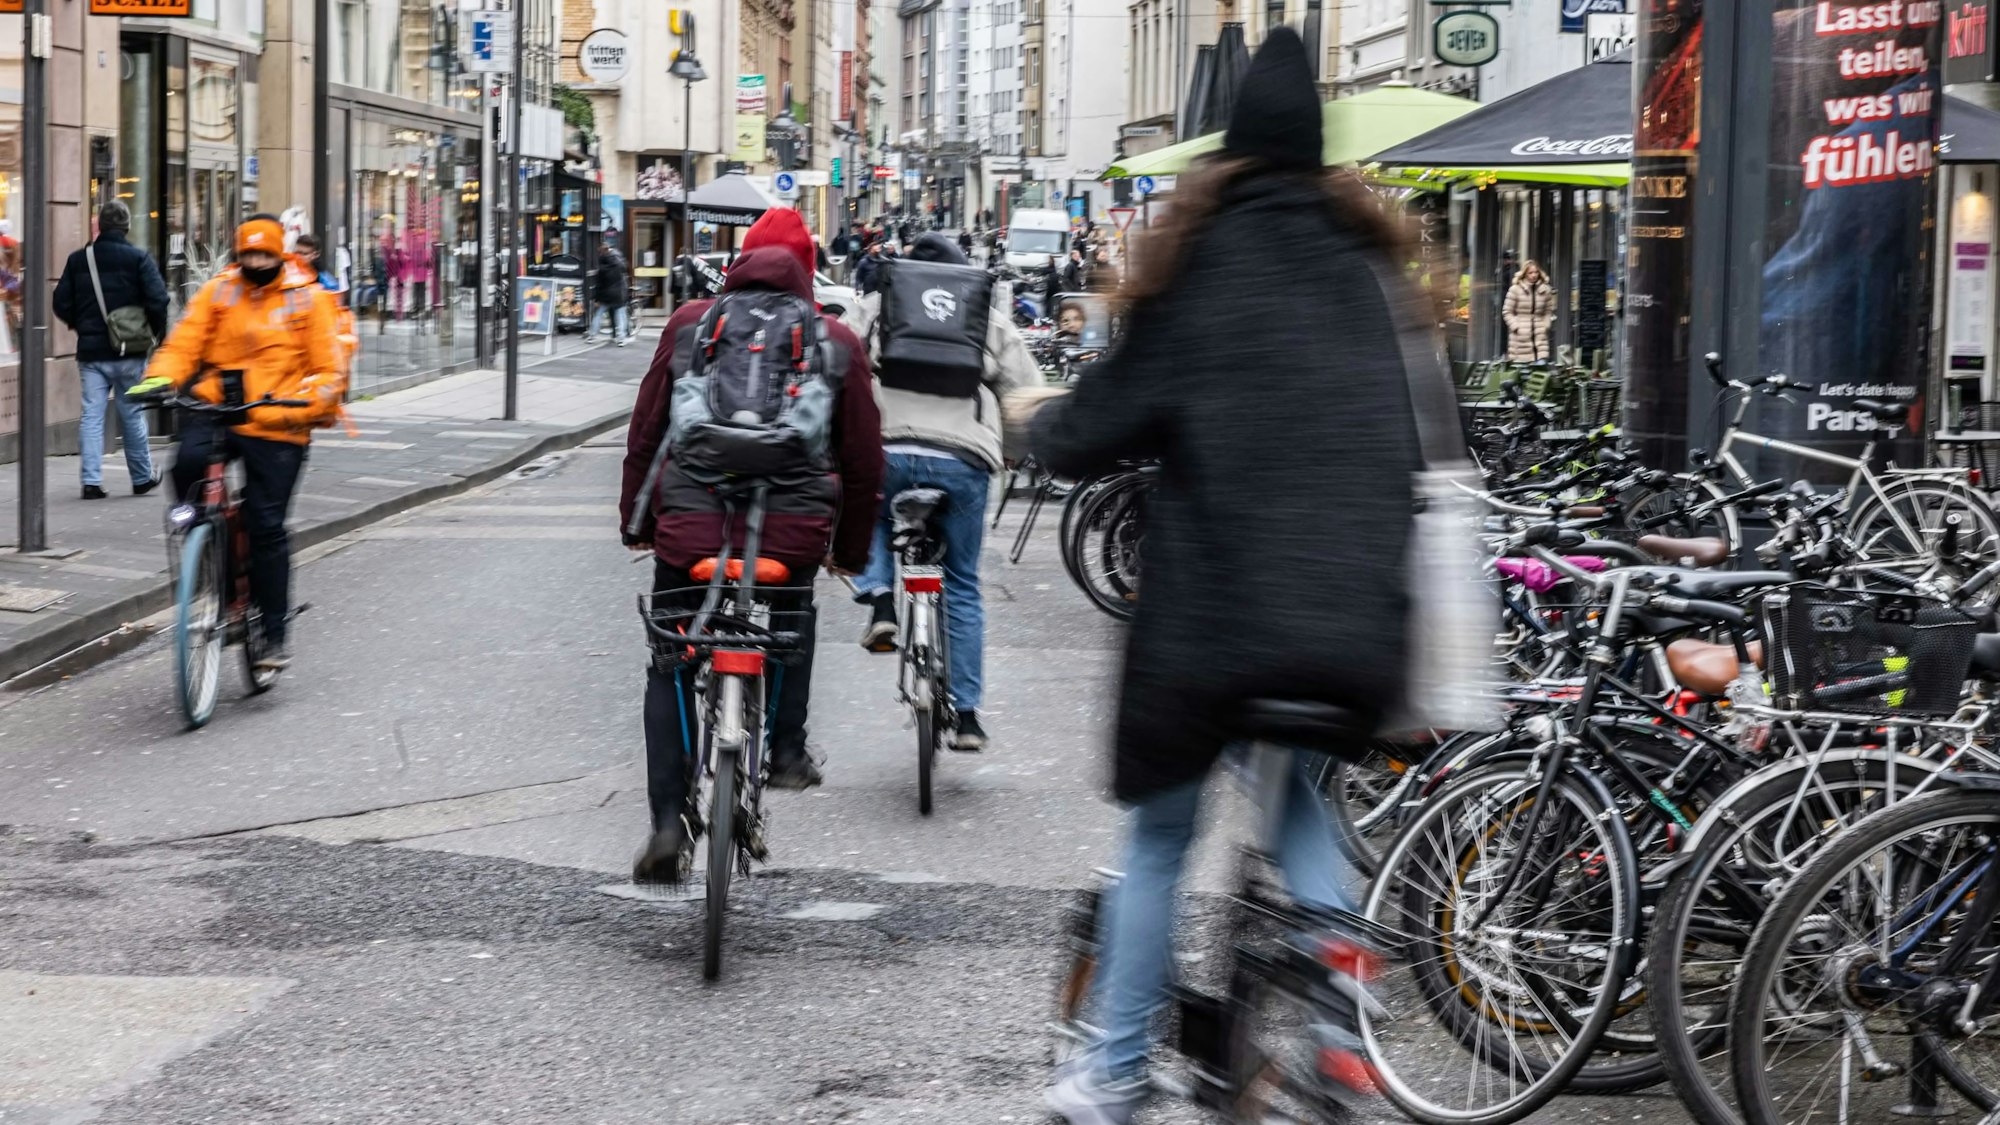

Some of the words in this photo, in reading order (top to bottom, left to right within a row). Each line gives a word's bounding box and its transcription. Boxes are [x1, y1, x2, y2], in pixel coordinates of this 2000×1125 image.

[1816, 1, 1904, 32] Lasst
[1907, 1, 1941, 24] uns
[588, 45, 626, 56] fritten
[1447, 30, 1488, 51] JEVER
[591, 56, 623, 65] werk
[1839, 40, 1929, 76] teilen,
[1825, 94, 1894, 121] was
[1899, 83, 1934, 115] wir
[1819, 382, 1855, 396] Let's
[1855, 382, 1885, 397] date
